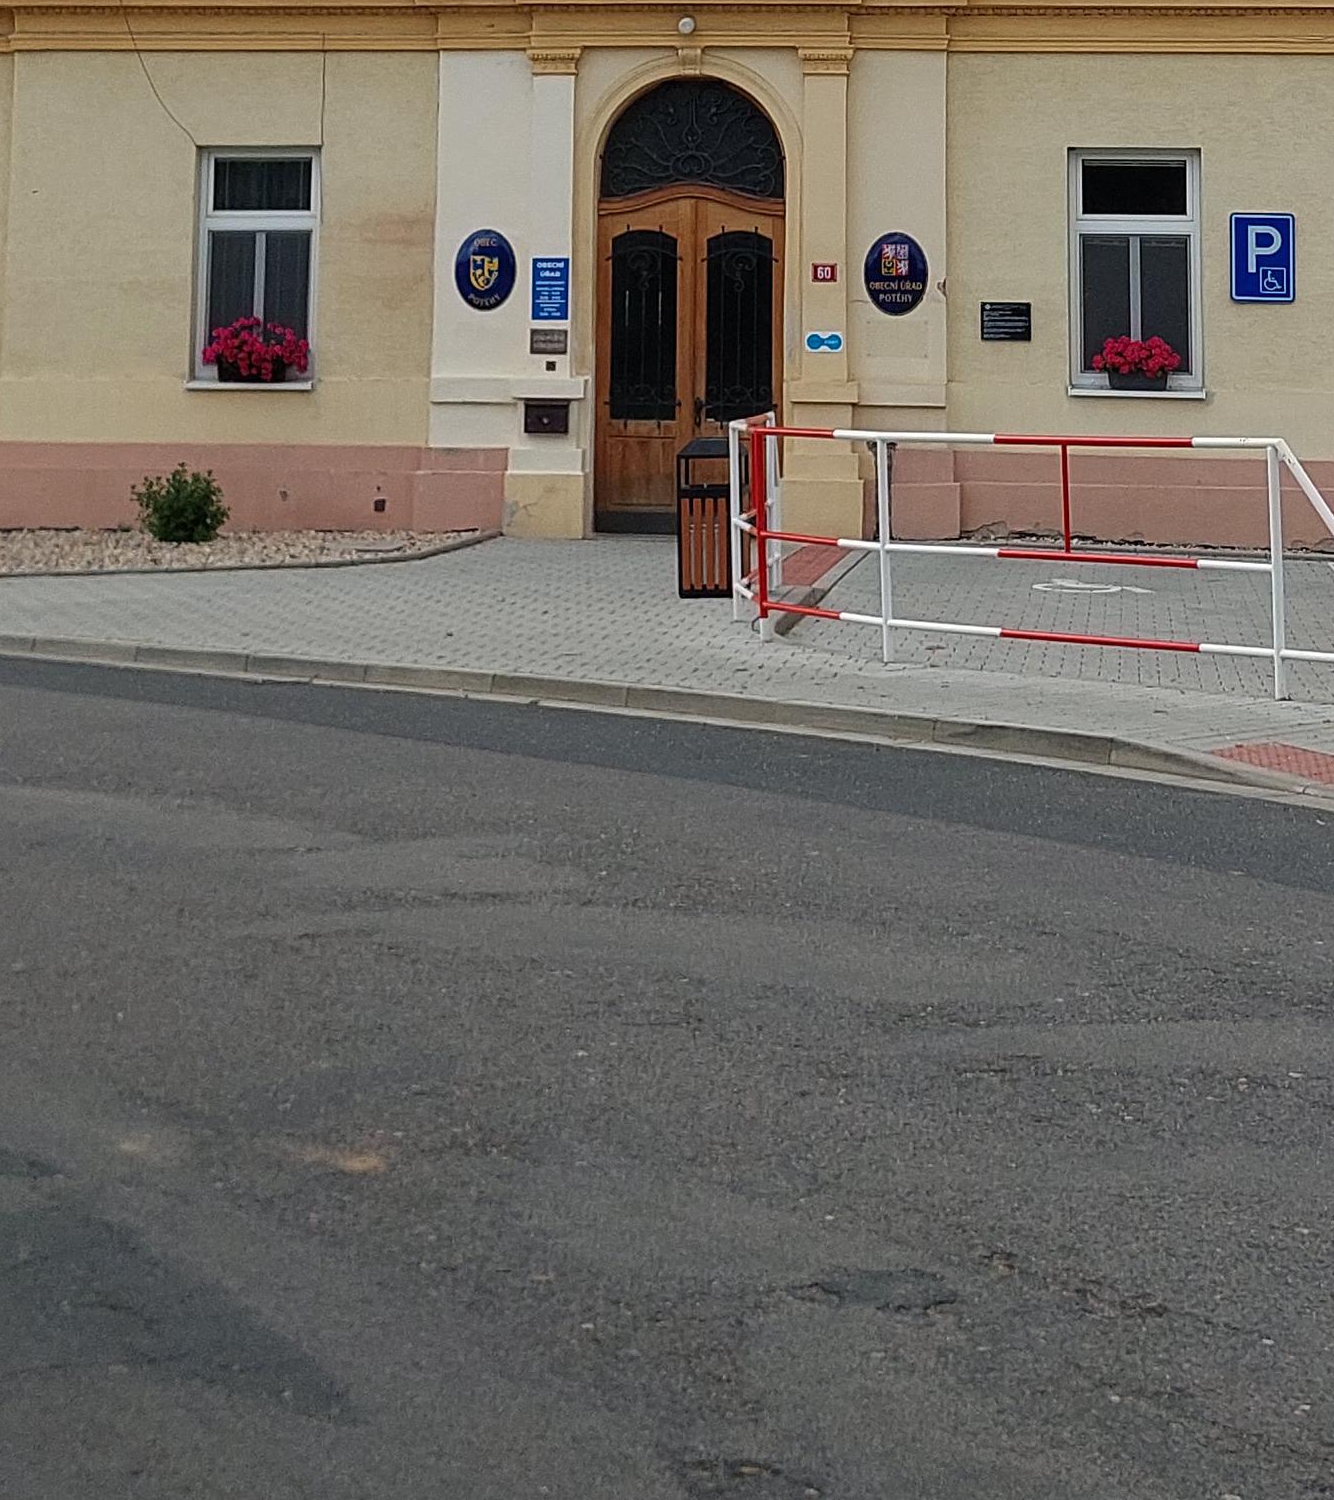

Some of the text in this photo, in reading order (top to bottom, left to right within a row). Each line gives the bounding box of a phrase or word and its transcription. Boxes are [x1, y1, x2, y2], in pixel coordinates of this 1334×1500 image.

[1248, 225, 1282, 273] P
[817, 267, 831, 279] 60
[869, 281, 922, 290] OBECNÍ ÚŘAD
